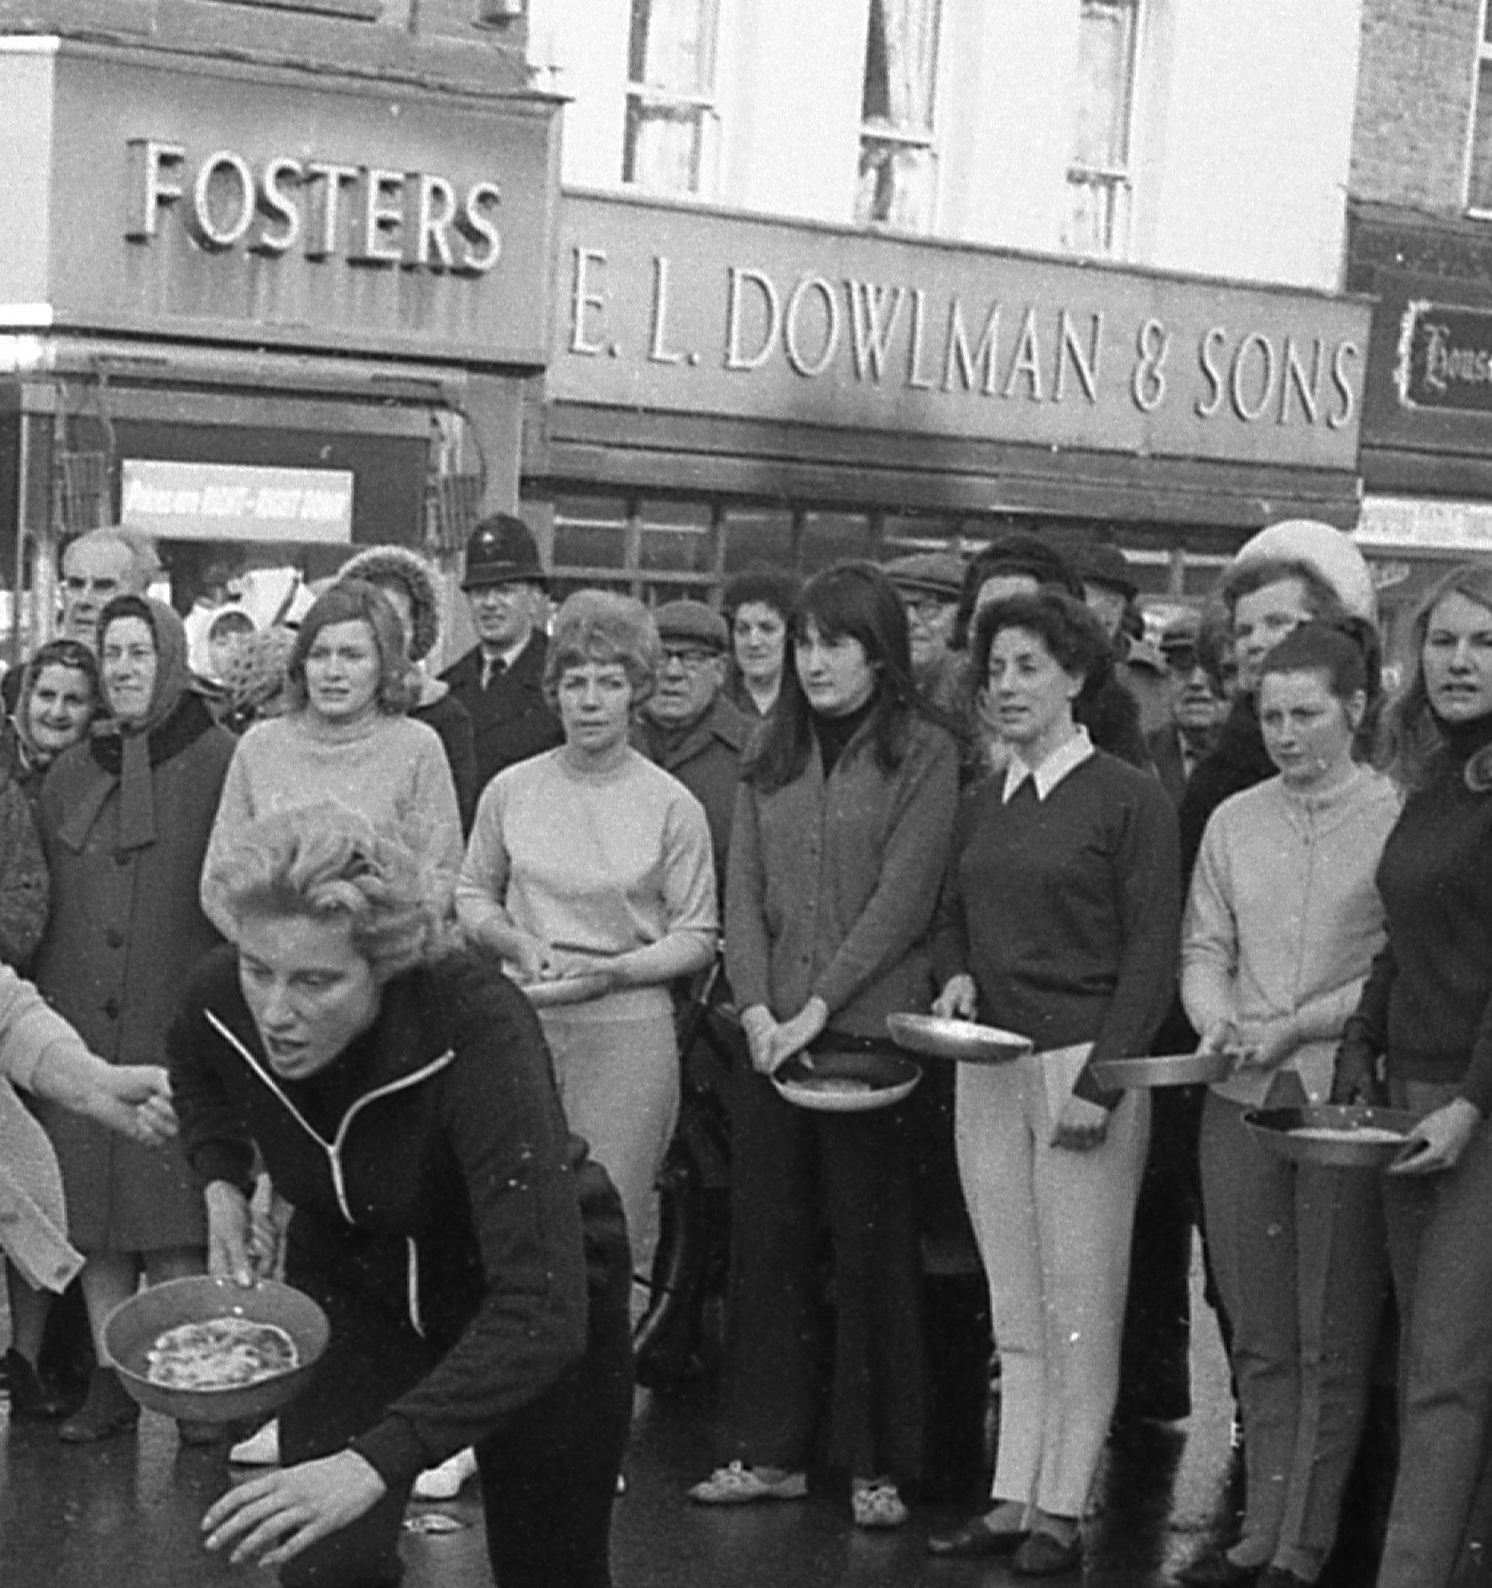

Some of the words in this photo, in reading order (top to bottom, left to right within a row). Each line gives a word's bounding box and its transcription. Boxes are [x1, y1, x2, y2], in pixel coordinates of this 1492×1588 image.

[129, 139, 502, 278] FOSTERS
[569, 247, 618, 358] E.
[648, 256, 701, 366] L.
[724, 266, 1104, 406] DOWLMAN
[1132, 318, 1173, 413] &
[1195, 327, 1358, 429] SONS
[1423, 323, 1492, 393] Hous
